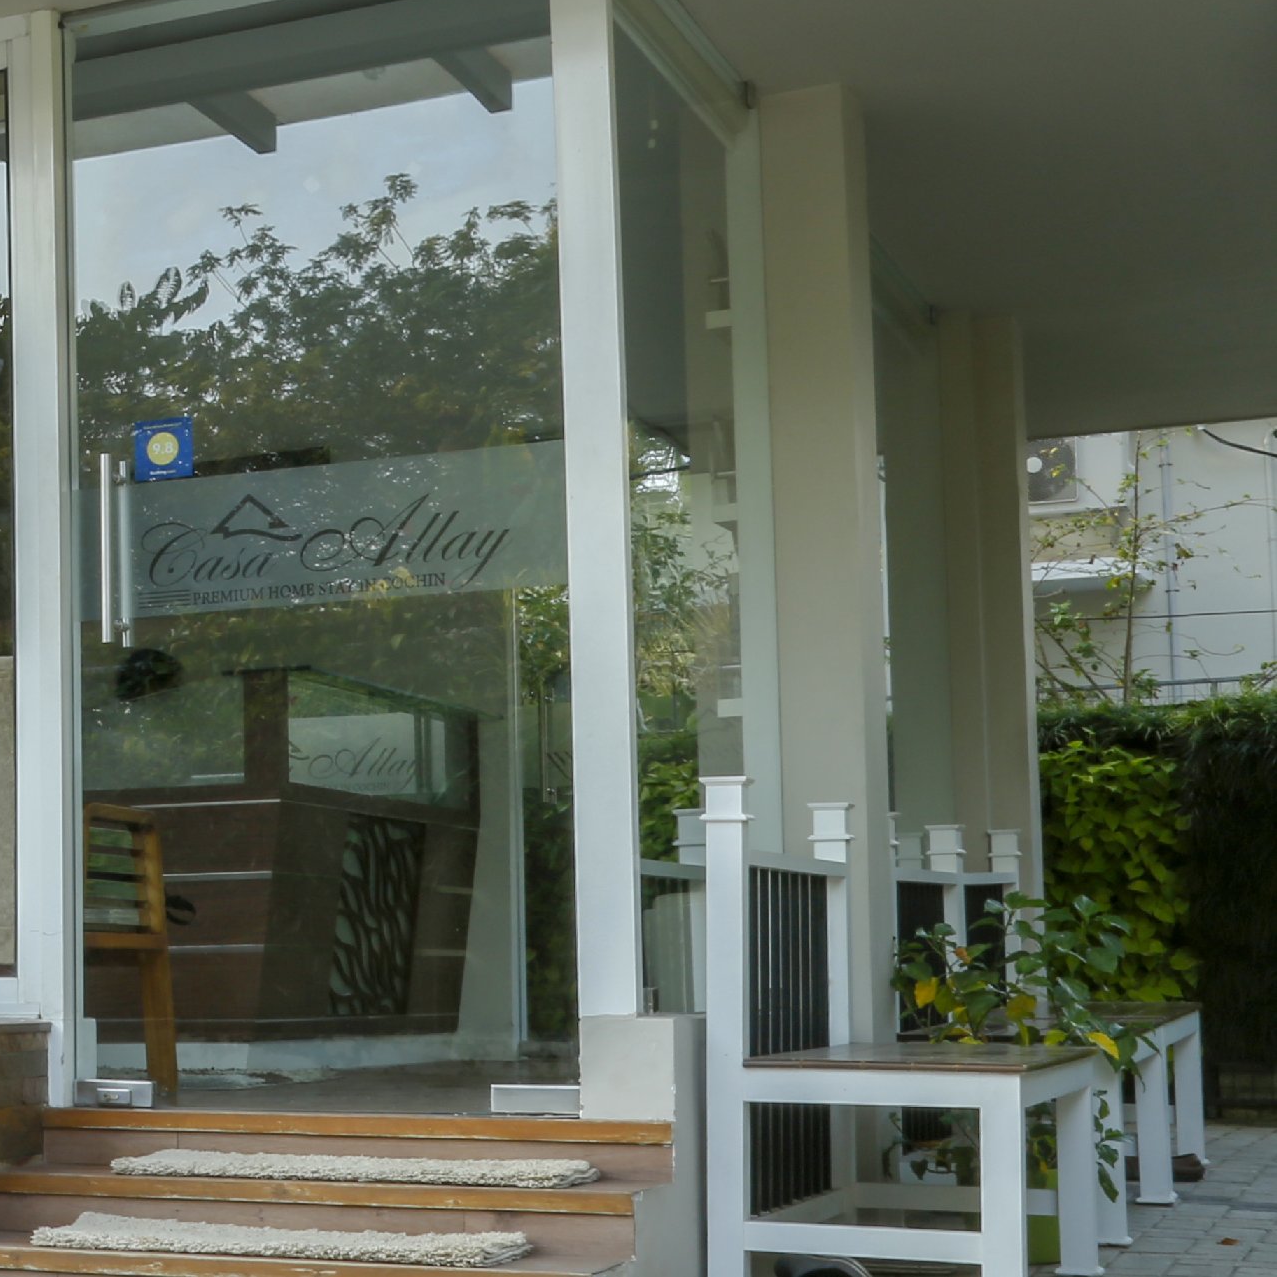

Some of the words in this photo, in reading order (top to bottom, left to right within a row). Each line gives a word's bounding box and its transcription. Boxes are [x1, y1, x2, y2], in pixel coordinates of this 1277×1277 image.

[142, 522, 273, 587] Casa
[300, 494, 510, 590] Allay
[192, 586, 264, 605] PREMIUM
[268, 583, 315, 600] HOME
[318, 579, 355, 596] STAY
[359, 577, 376, 592] IN
[380, 572, 446, 591] COCHIN
